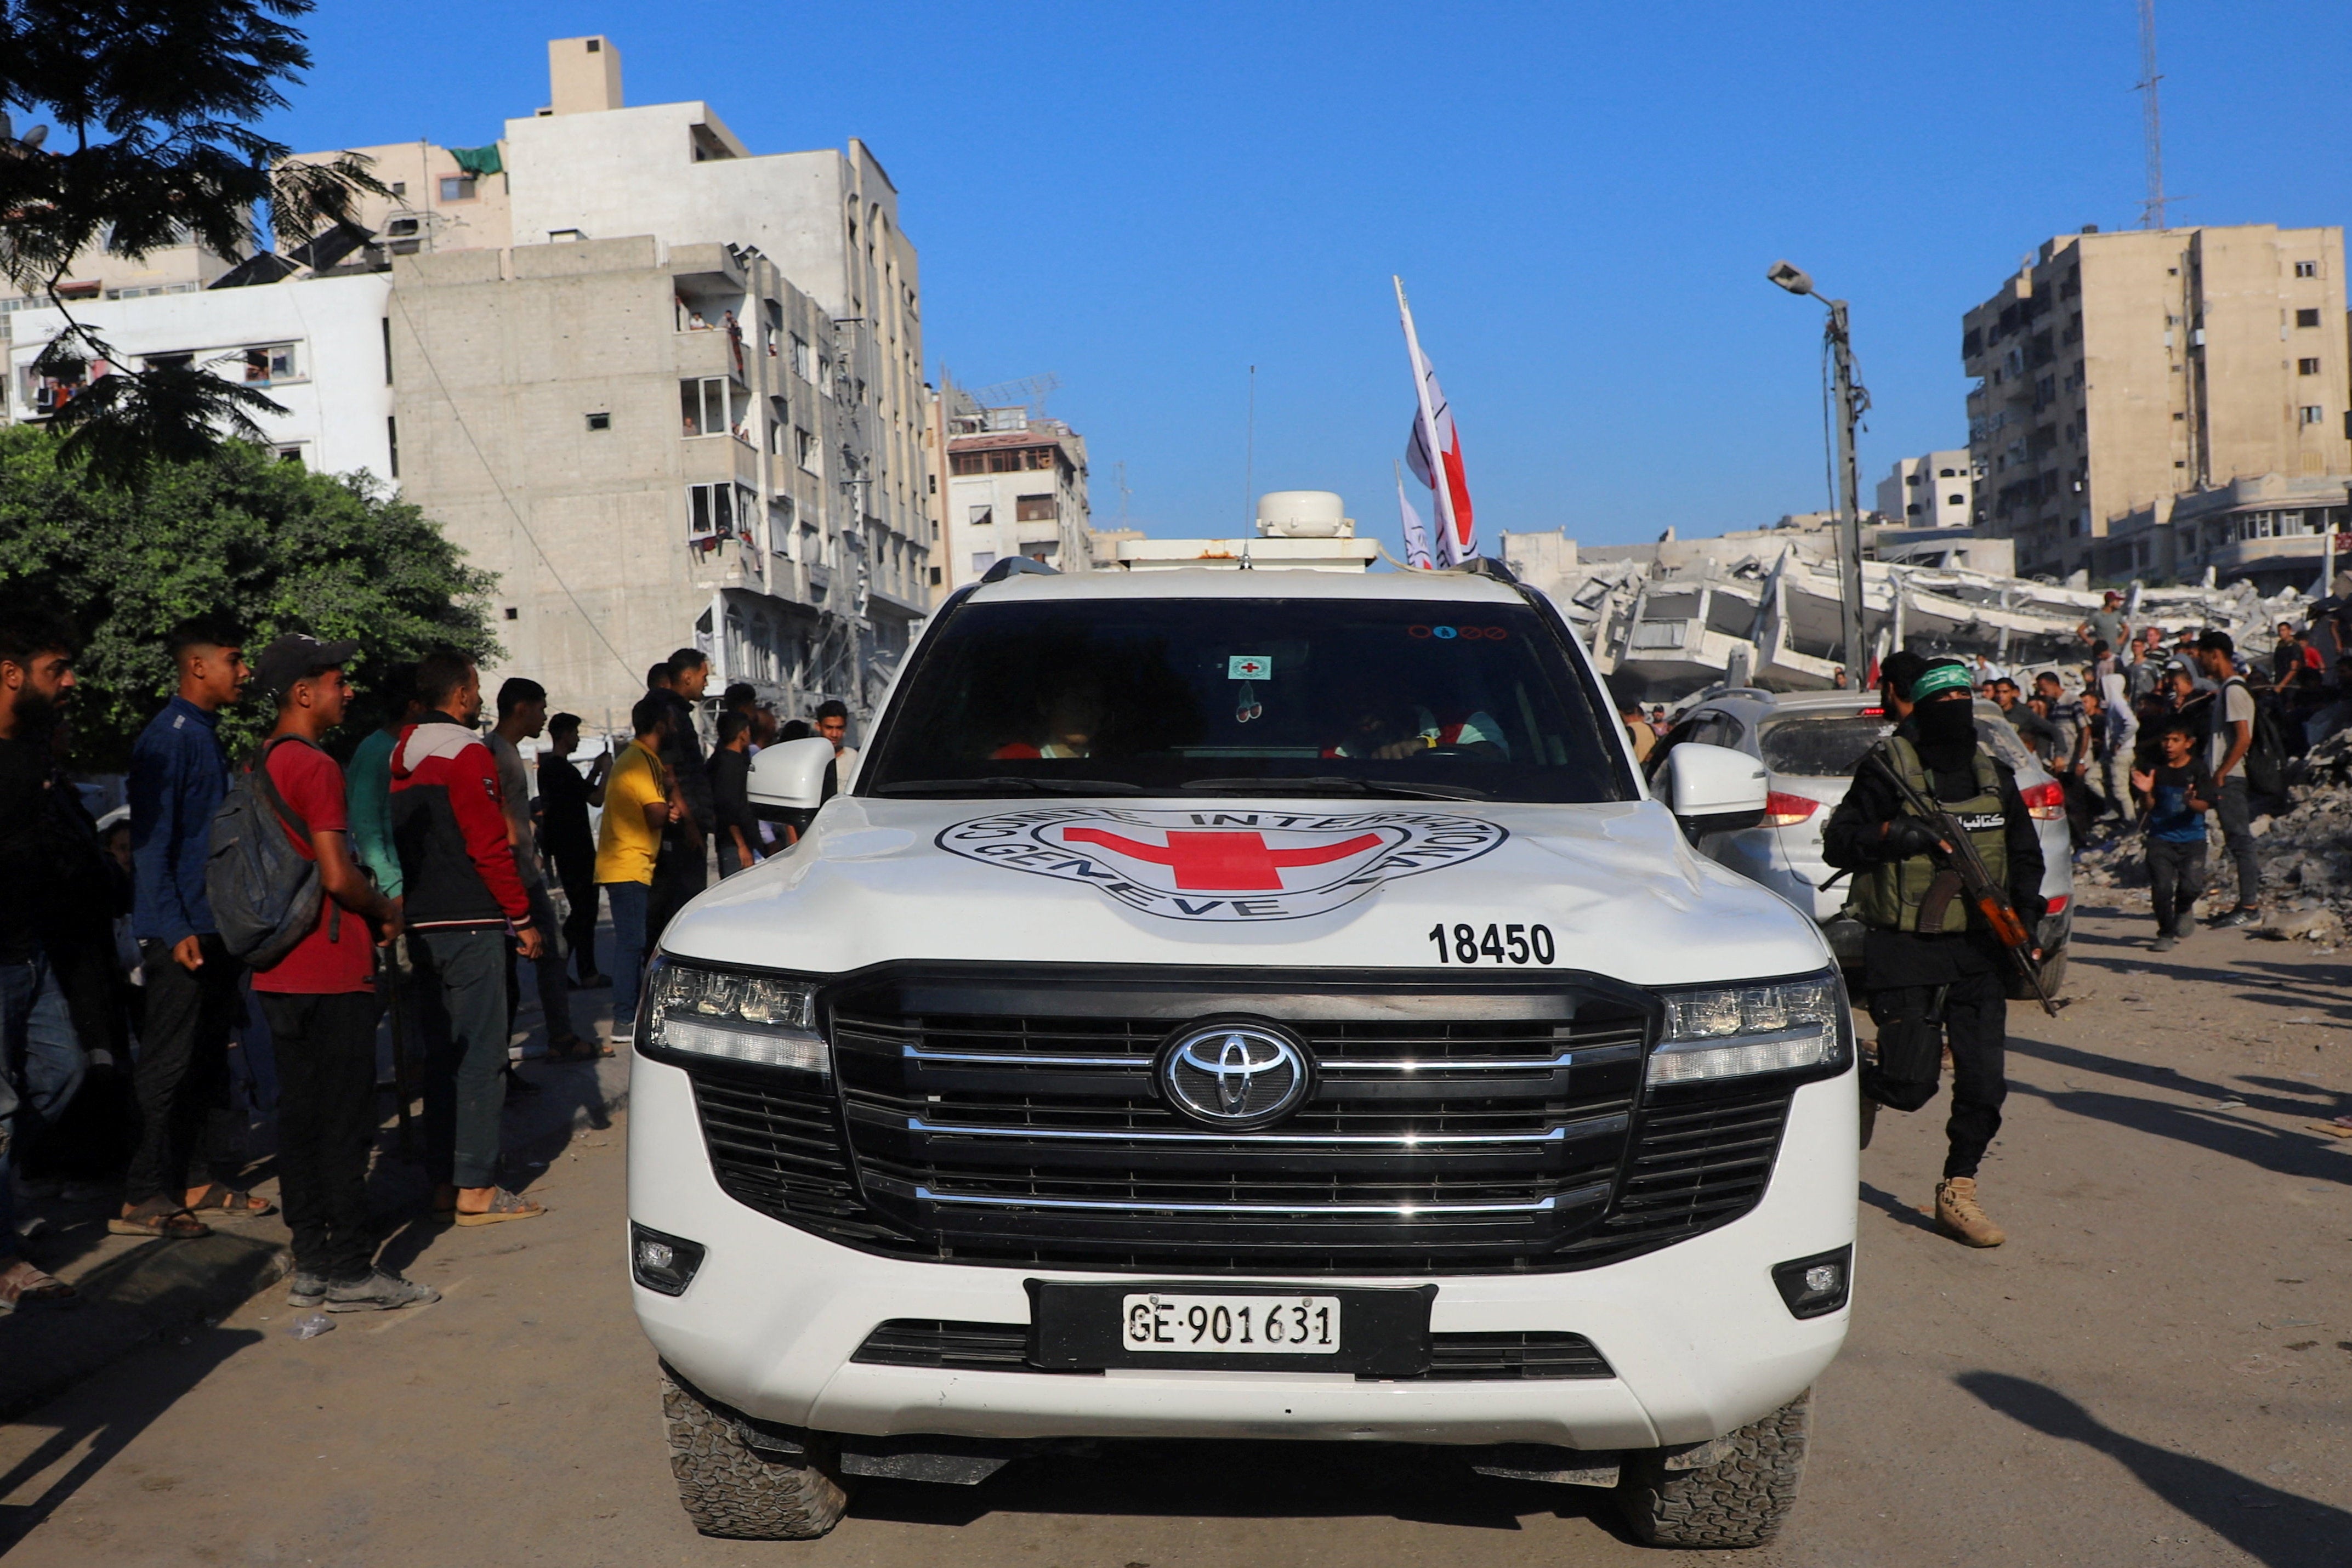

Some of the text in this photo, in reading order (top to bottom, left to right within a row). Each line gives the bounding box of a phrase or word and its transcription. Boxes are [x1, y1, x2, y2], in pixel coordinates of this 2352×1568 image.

[974, 844, 1289, 916] GENEVE
[1190, 812, 1493, 895] INTERNATIONAL
[1429, 923, 1555, 965] 18450
